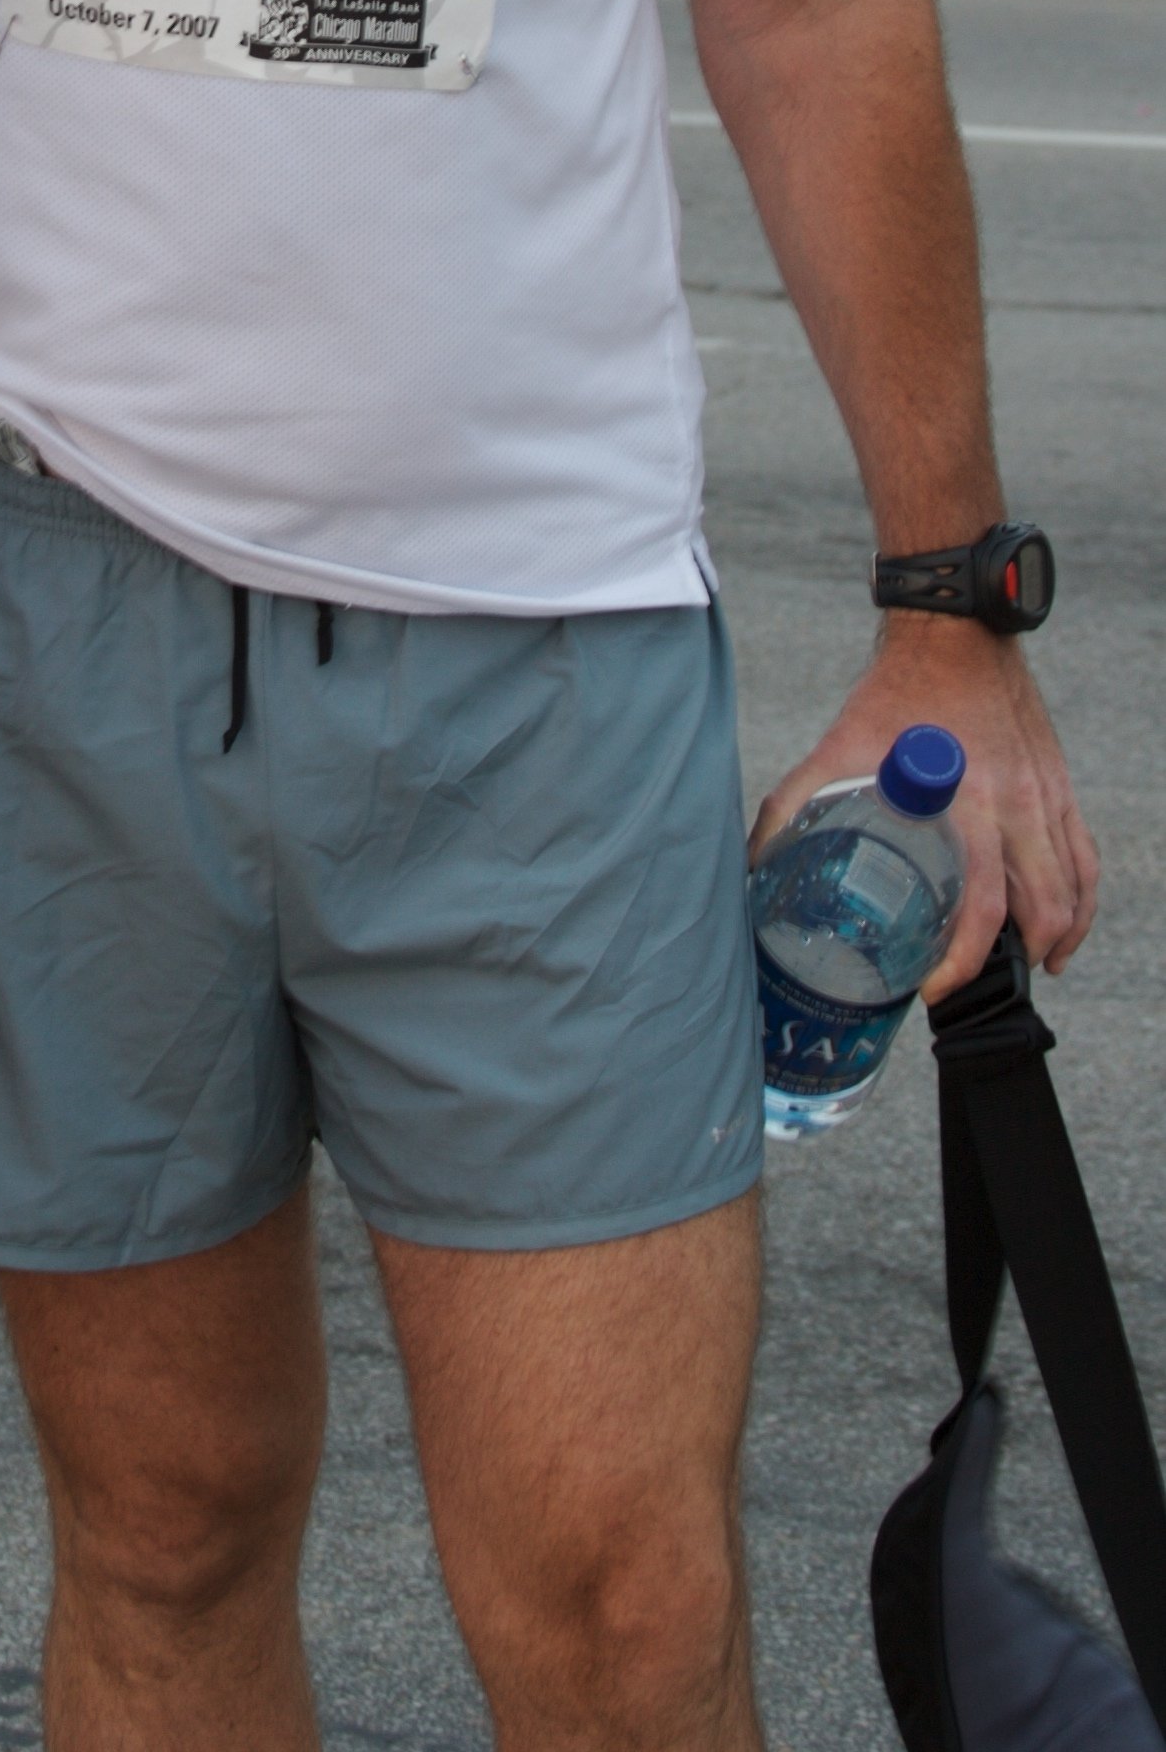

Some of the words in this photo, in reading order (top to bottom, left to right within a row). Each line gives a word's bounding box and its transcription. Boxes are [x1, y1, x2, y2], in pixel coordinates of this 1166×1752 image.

[343, 0, 387, 12] LaSalle
[391, 1, 421, 13] Bank
[143, 9, 160, 36] 7,
[166, 13, 221, 39] 2007
[313, 12, 361, 44] Chicago
[364, 16, 419, 43] Marathon
[304, 48, 411, 66] ANNIVERSARY
